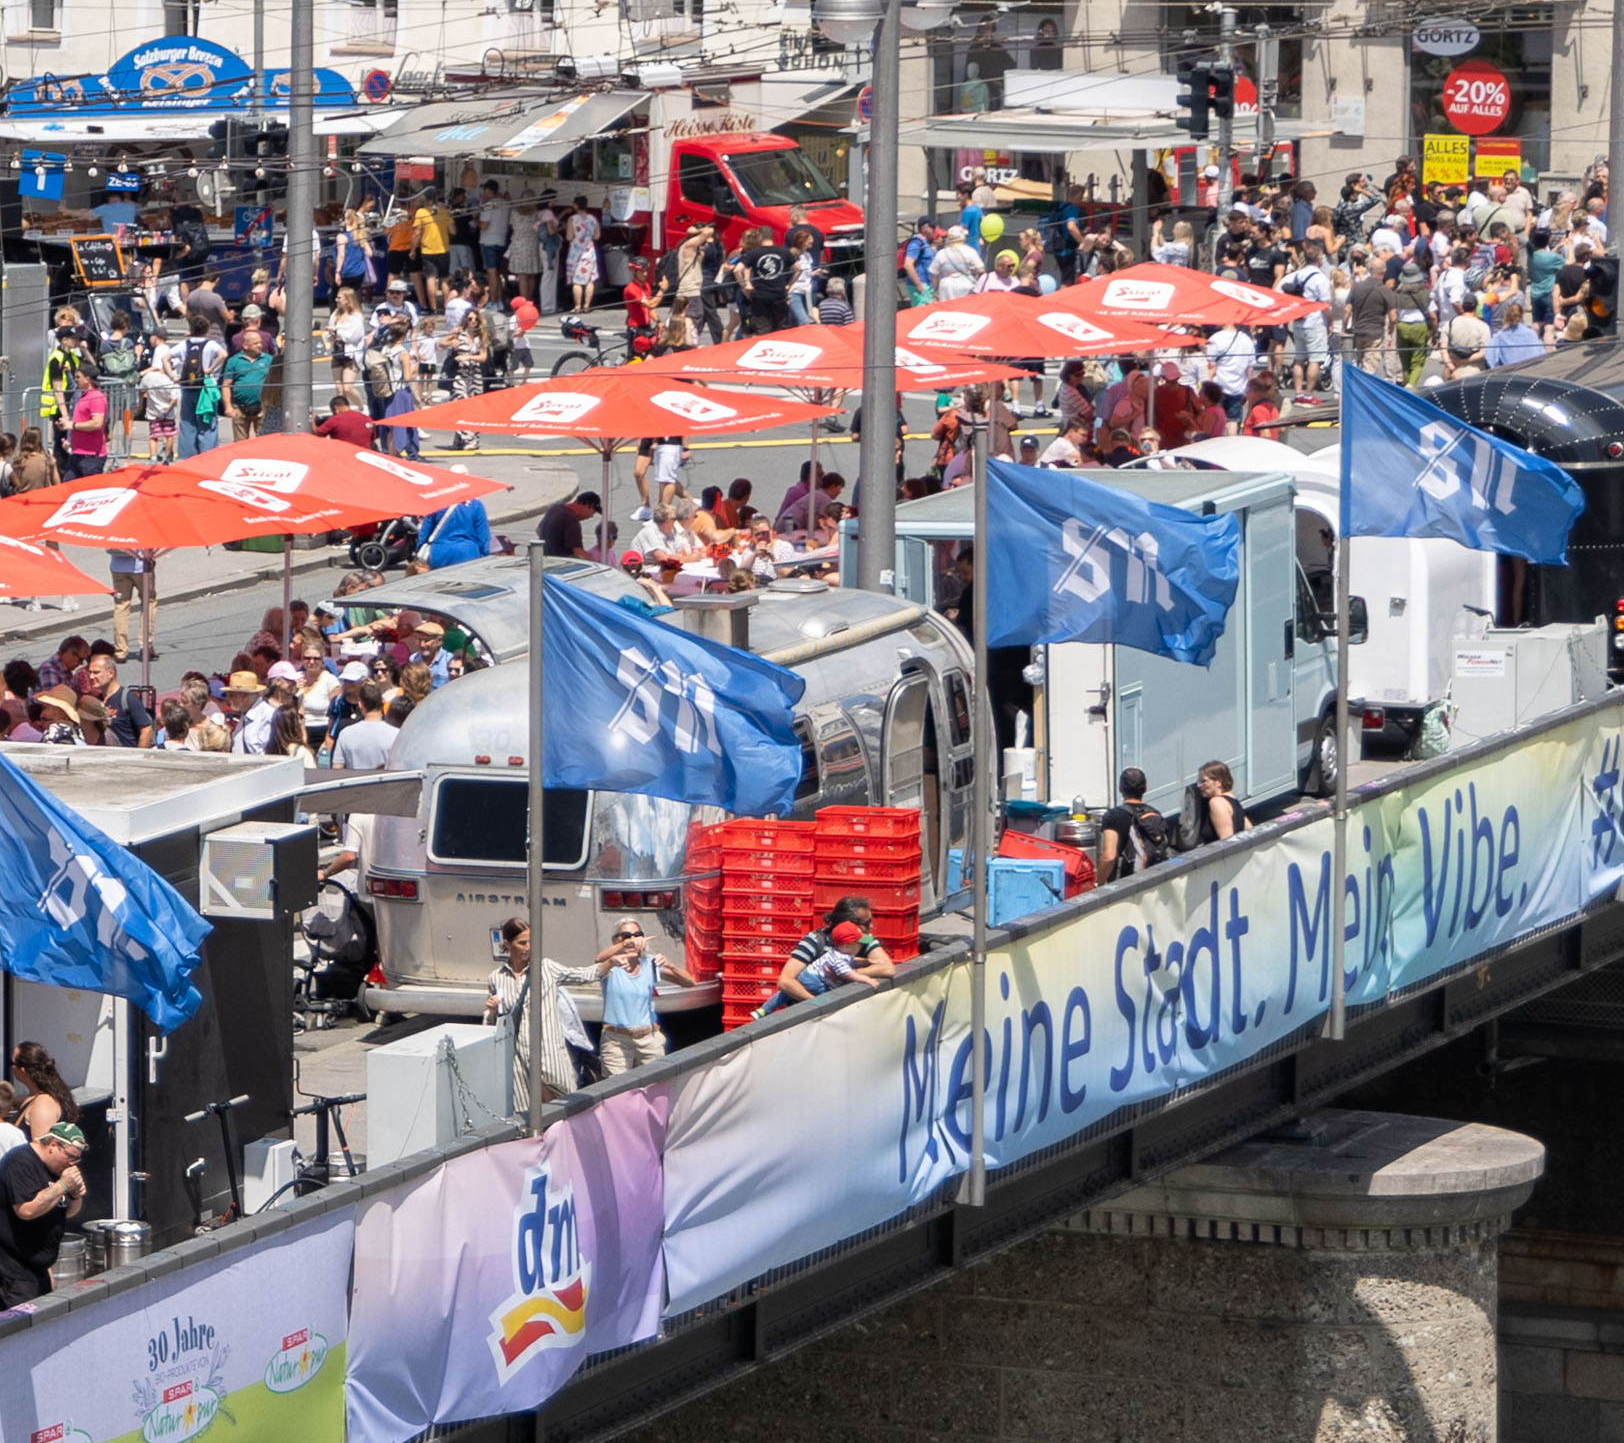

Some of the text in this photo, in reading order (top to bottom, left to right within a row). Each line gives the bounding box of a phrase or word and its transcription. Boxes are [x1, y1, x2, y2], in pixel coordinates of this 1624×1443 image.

[1416, 27, 1475, 45] GÖRTZ
[132, 46, 189, 71] Salzburger
[1446, 79, 1506, 106] -20%
[1448, 103, 1503, 117] AUF ALLES
[663, 112, 758, 140] Heisse Kiste
[1425, 141, 1468, 155] ALLES
[959, 165, 1019, 183] GRTZ
[455, 892, 567, 908] AIRSTRAM
[898, 971, 1092, 1184] Meine
[1109, 880, 1266, 1094] Stadt.
[1284, 823, 1396, 1015] Mein
[1417, 780, 1528, 949] Vibe.
[515, 1166, 583, 1294] dm
[147, 1315, 216, 1372] 30 Jahre
[286, 1330, 308, 1348] SPAR
[268, 1344, 327, 1386] Natur pur
[167, 1383, 193, 1400] SPAR
[147, 1393, 219, 1440] Natur pur
[35, 1426, 64, 1443] SPAR
